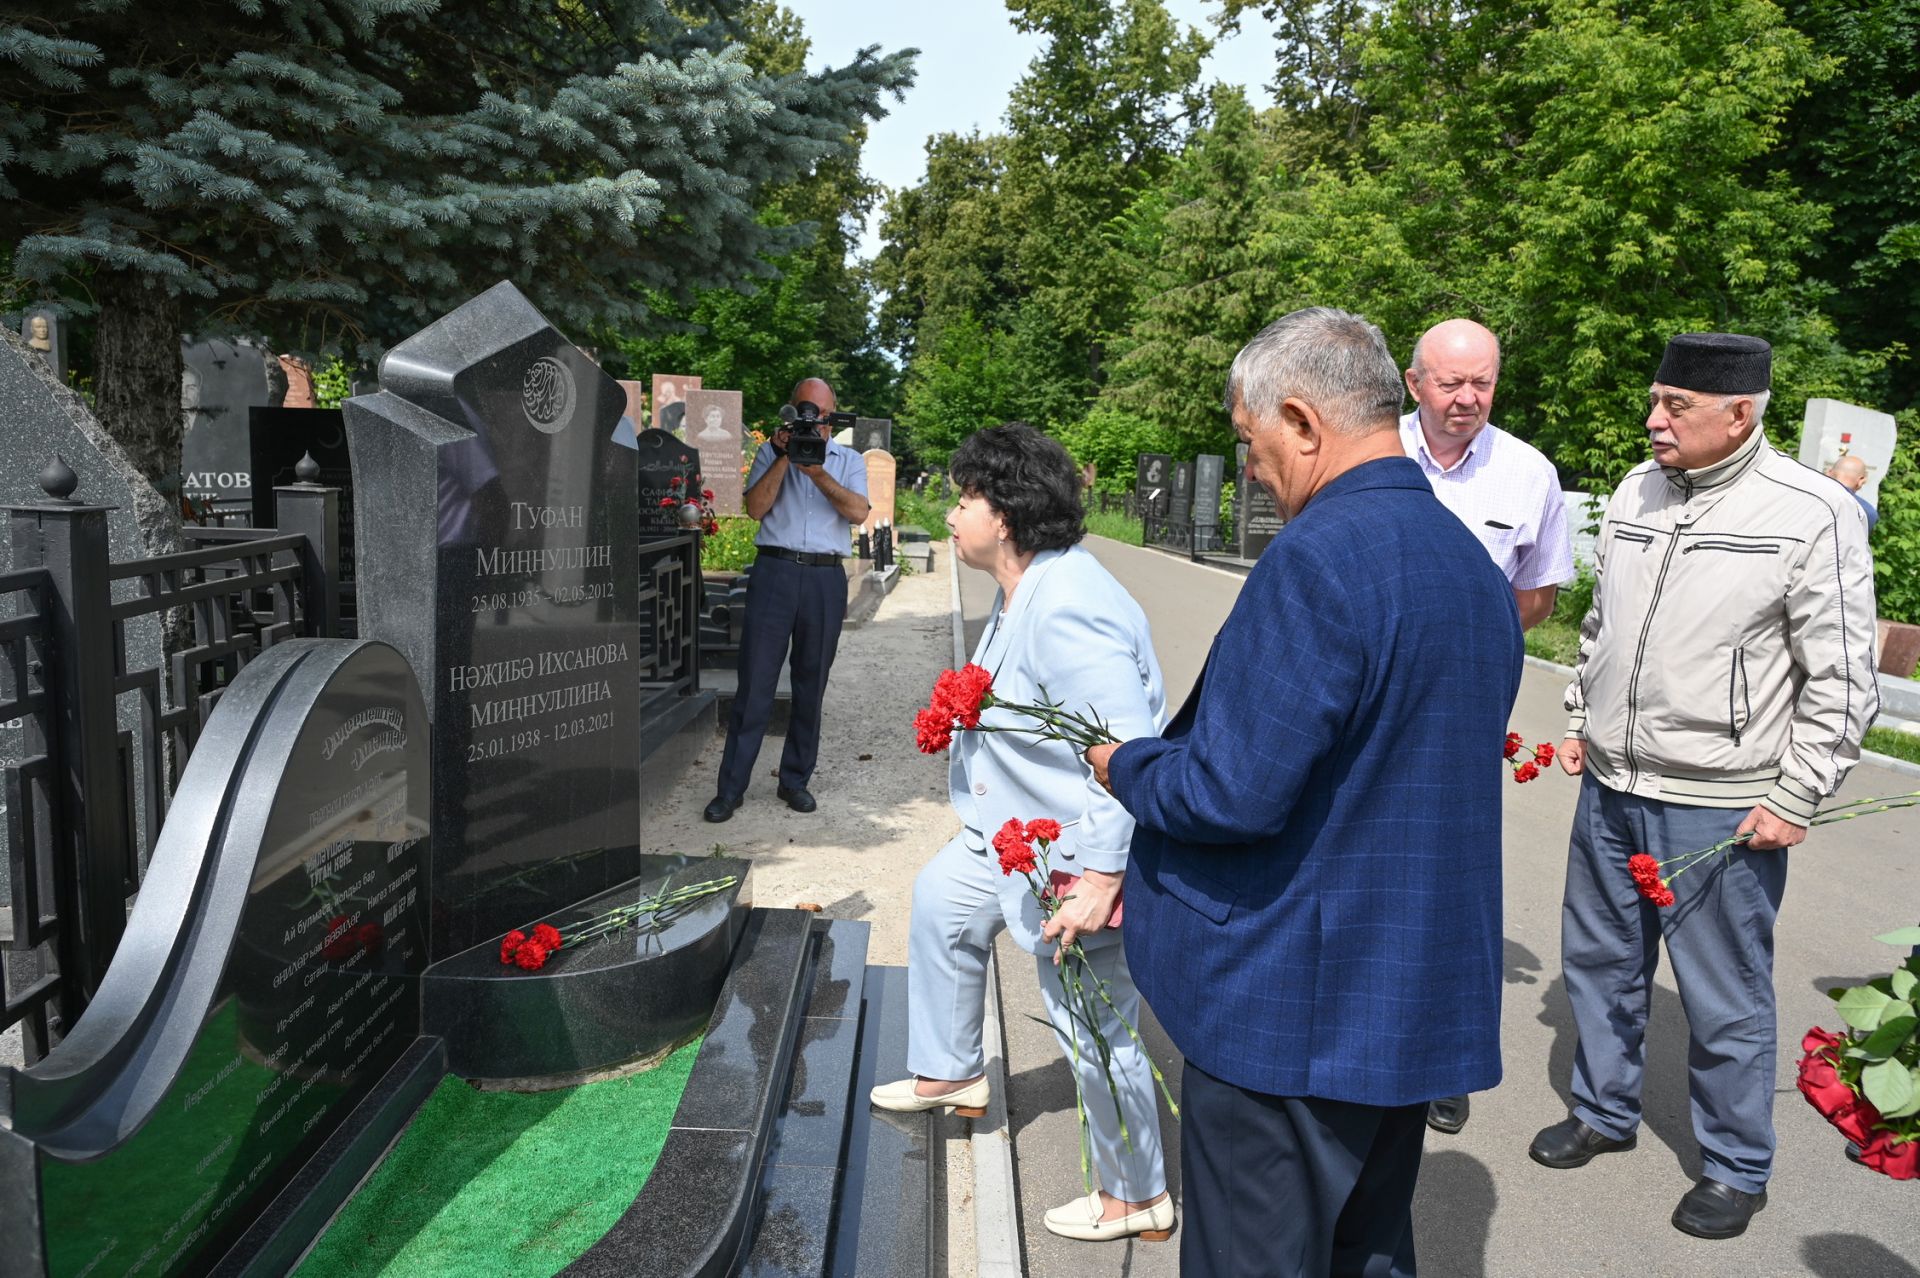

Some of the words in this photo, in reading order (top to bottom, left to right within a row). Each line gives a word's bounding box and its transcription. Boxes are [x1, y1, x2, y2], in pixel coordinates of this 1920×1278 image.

[180, 471, 251, 489] АТОВ
[471, 590, 540, 613] 25.08.1935
[554, 583, 614, 604] 02.05.2012
[467, 729, 541, 763] 25.01.1938
[554, 711, 615, 742] 12.03.2021
